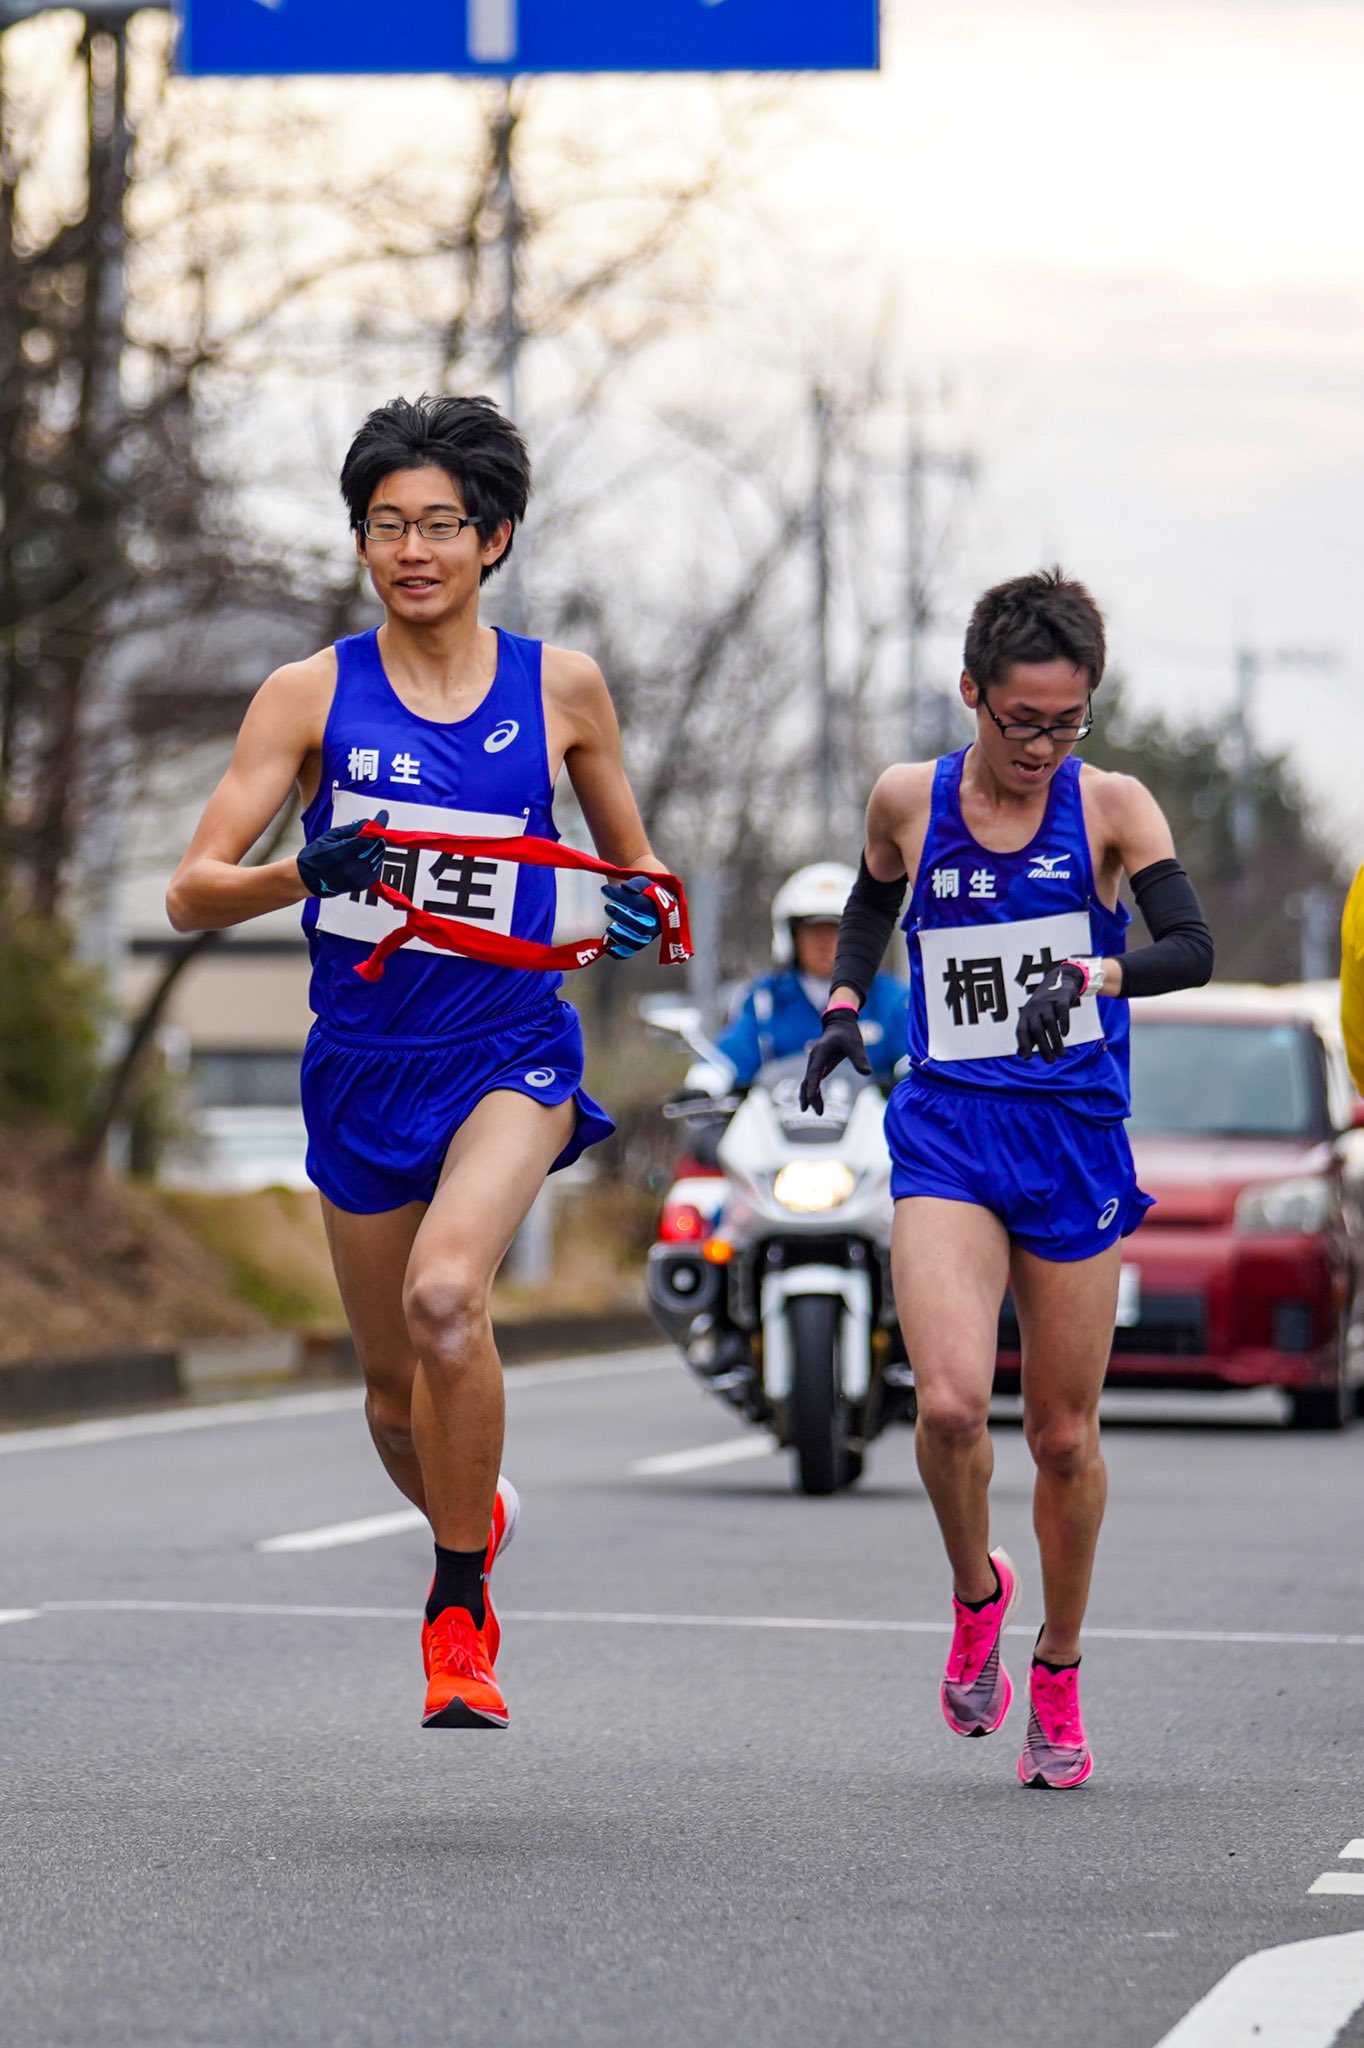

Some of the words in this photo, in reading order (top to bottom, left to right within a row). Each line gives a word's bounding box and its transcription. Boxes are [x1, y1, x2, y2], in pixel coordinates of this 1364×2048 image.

[347, 747, 421, 785] 桐生
[932, 868, 997, 898] 桐生
[1027, 868, 1071, 880] MIZUNO
